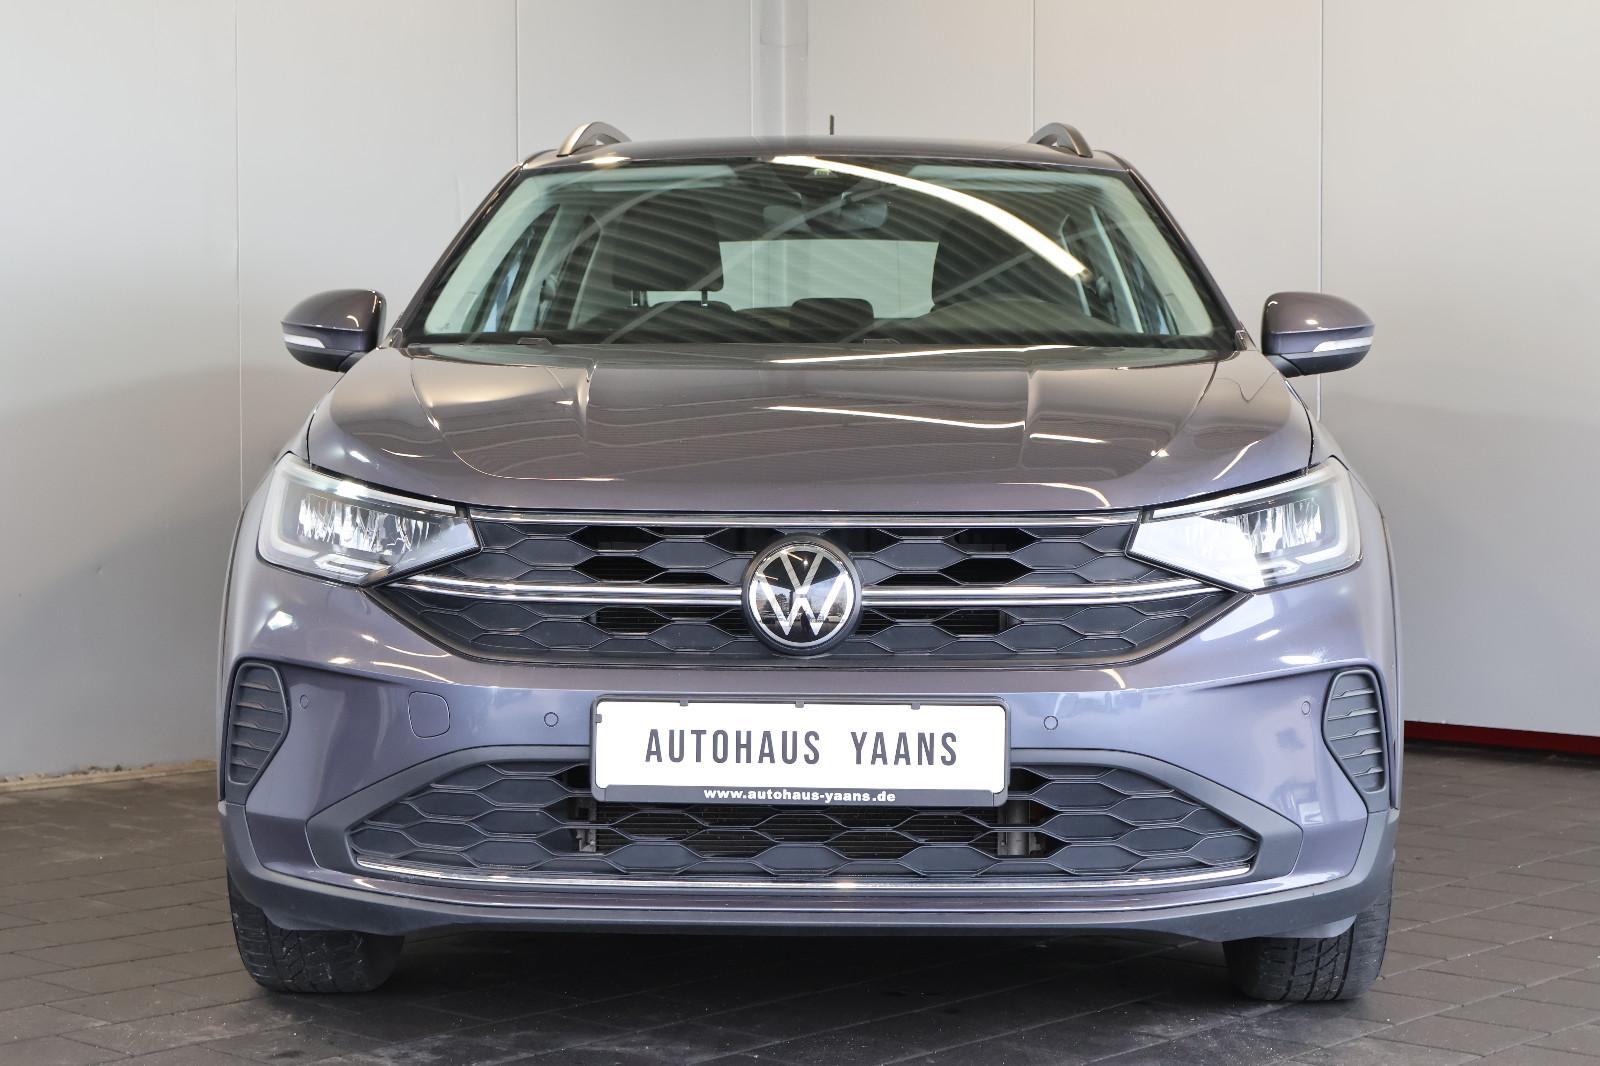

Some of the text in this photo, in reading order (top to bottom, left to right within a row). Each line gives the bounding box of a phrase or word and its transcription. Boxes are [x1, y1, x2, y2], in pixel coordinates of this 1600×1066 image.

[645, 728, 957, 766] AUTOHAUS YAANS
[703, 787, 896, 804] www.autohaus-yaans.de
